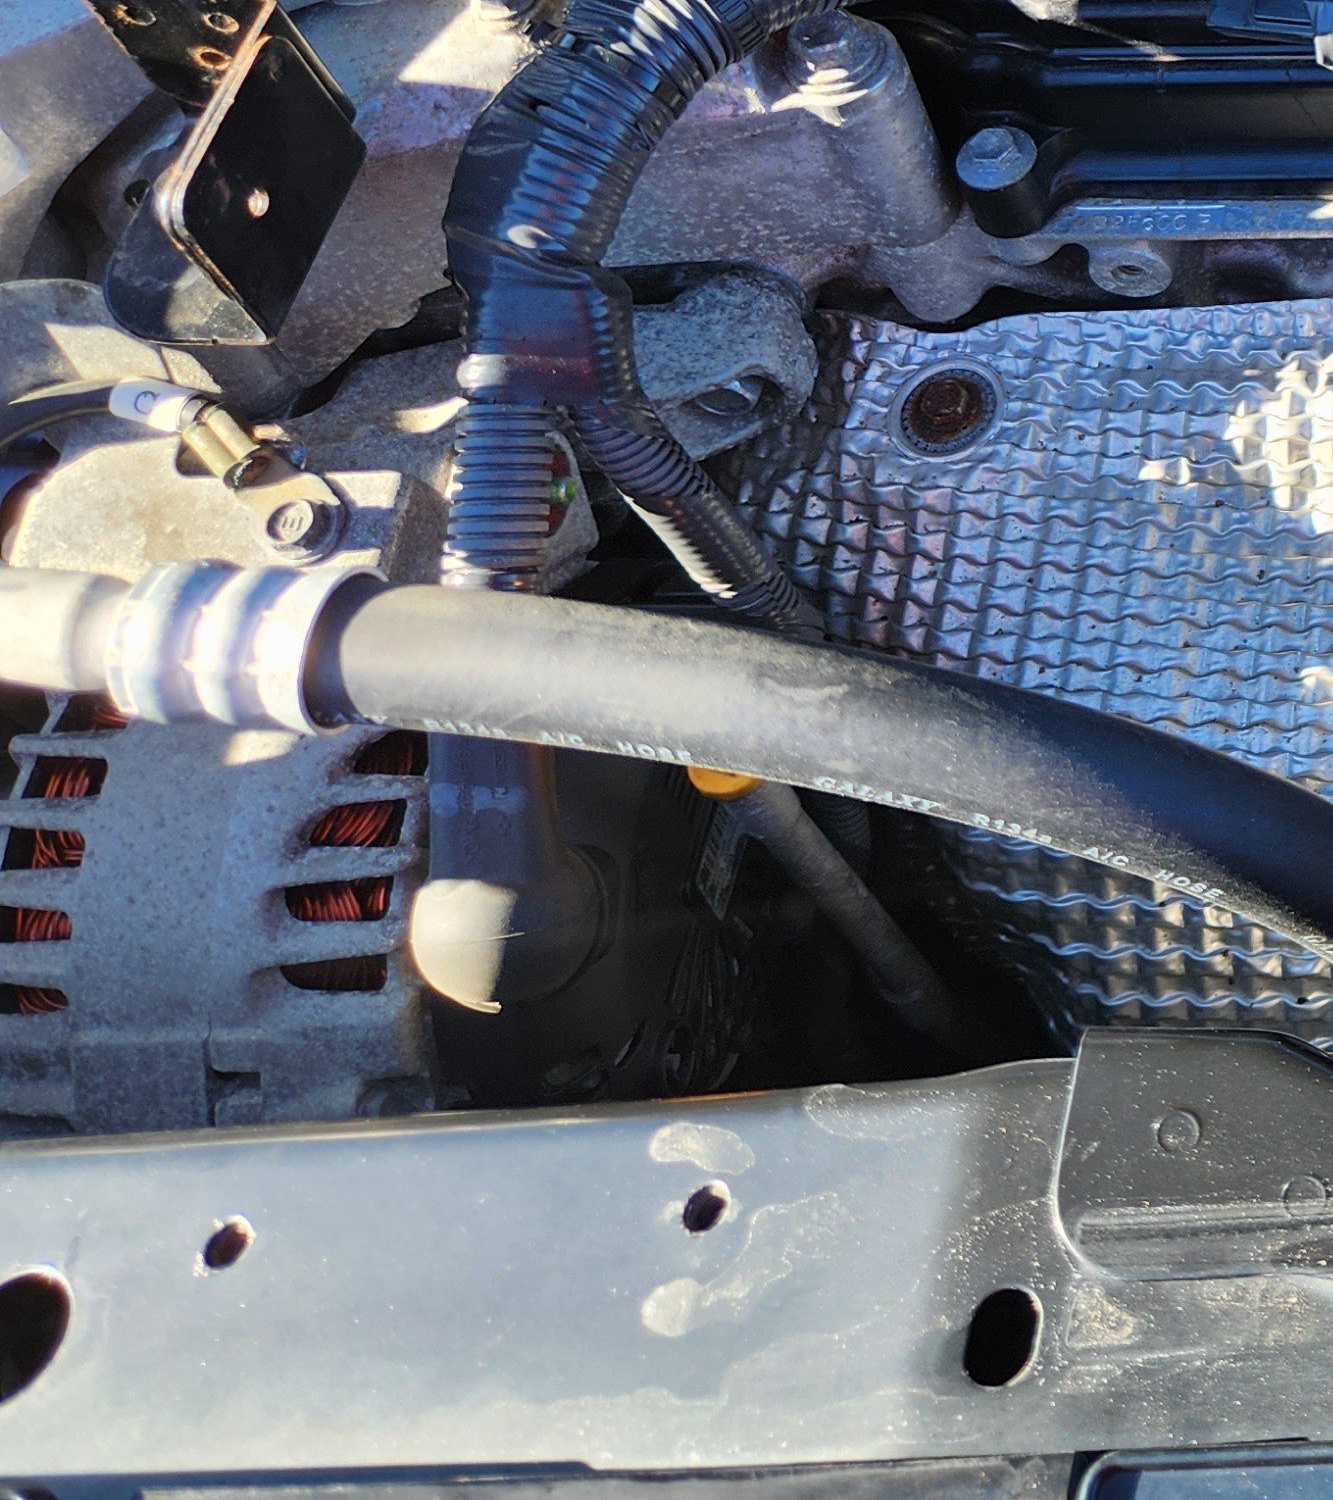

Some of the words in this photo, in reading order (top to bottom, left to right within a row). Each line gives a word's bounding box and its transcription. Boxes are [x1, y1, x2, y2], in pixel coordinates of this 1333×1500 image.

[812, 774, 943, 813] GALAXY
[1081, 846, 1130, 868] A/C
[1154, 868, 1225, 900] HOSE
